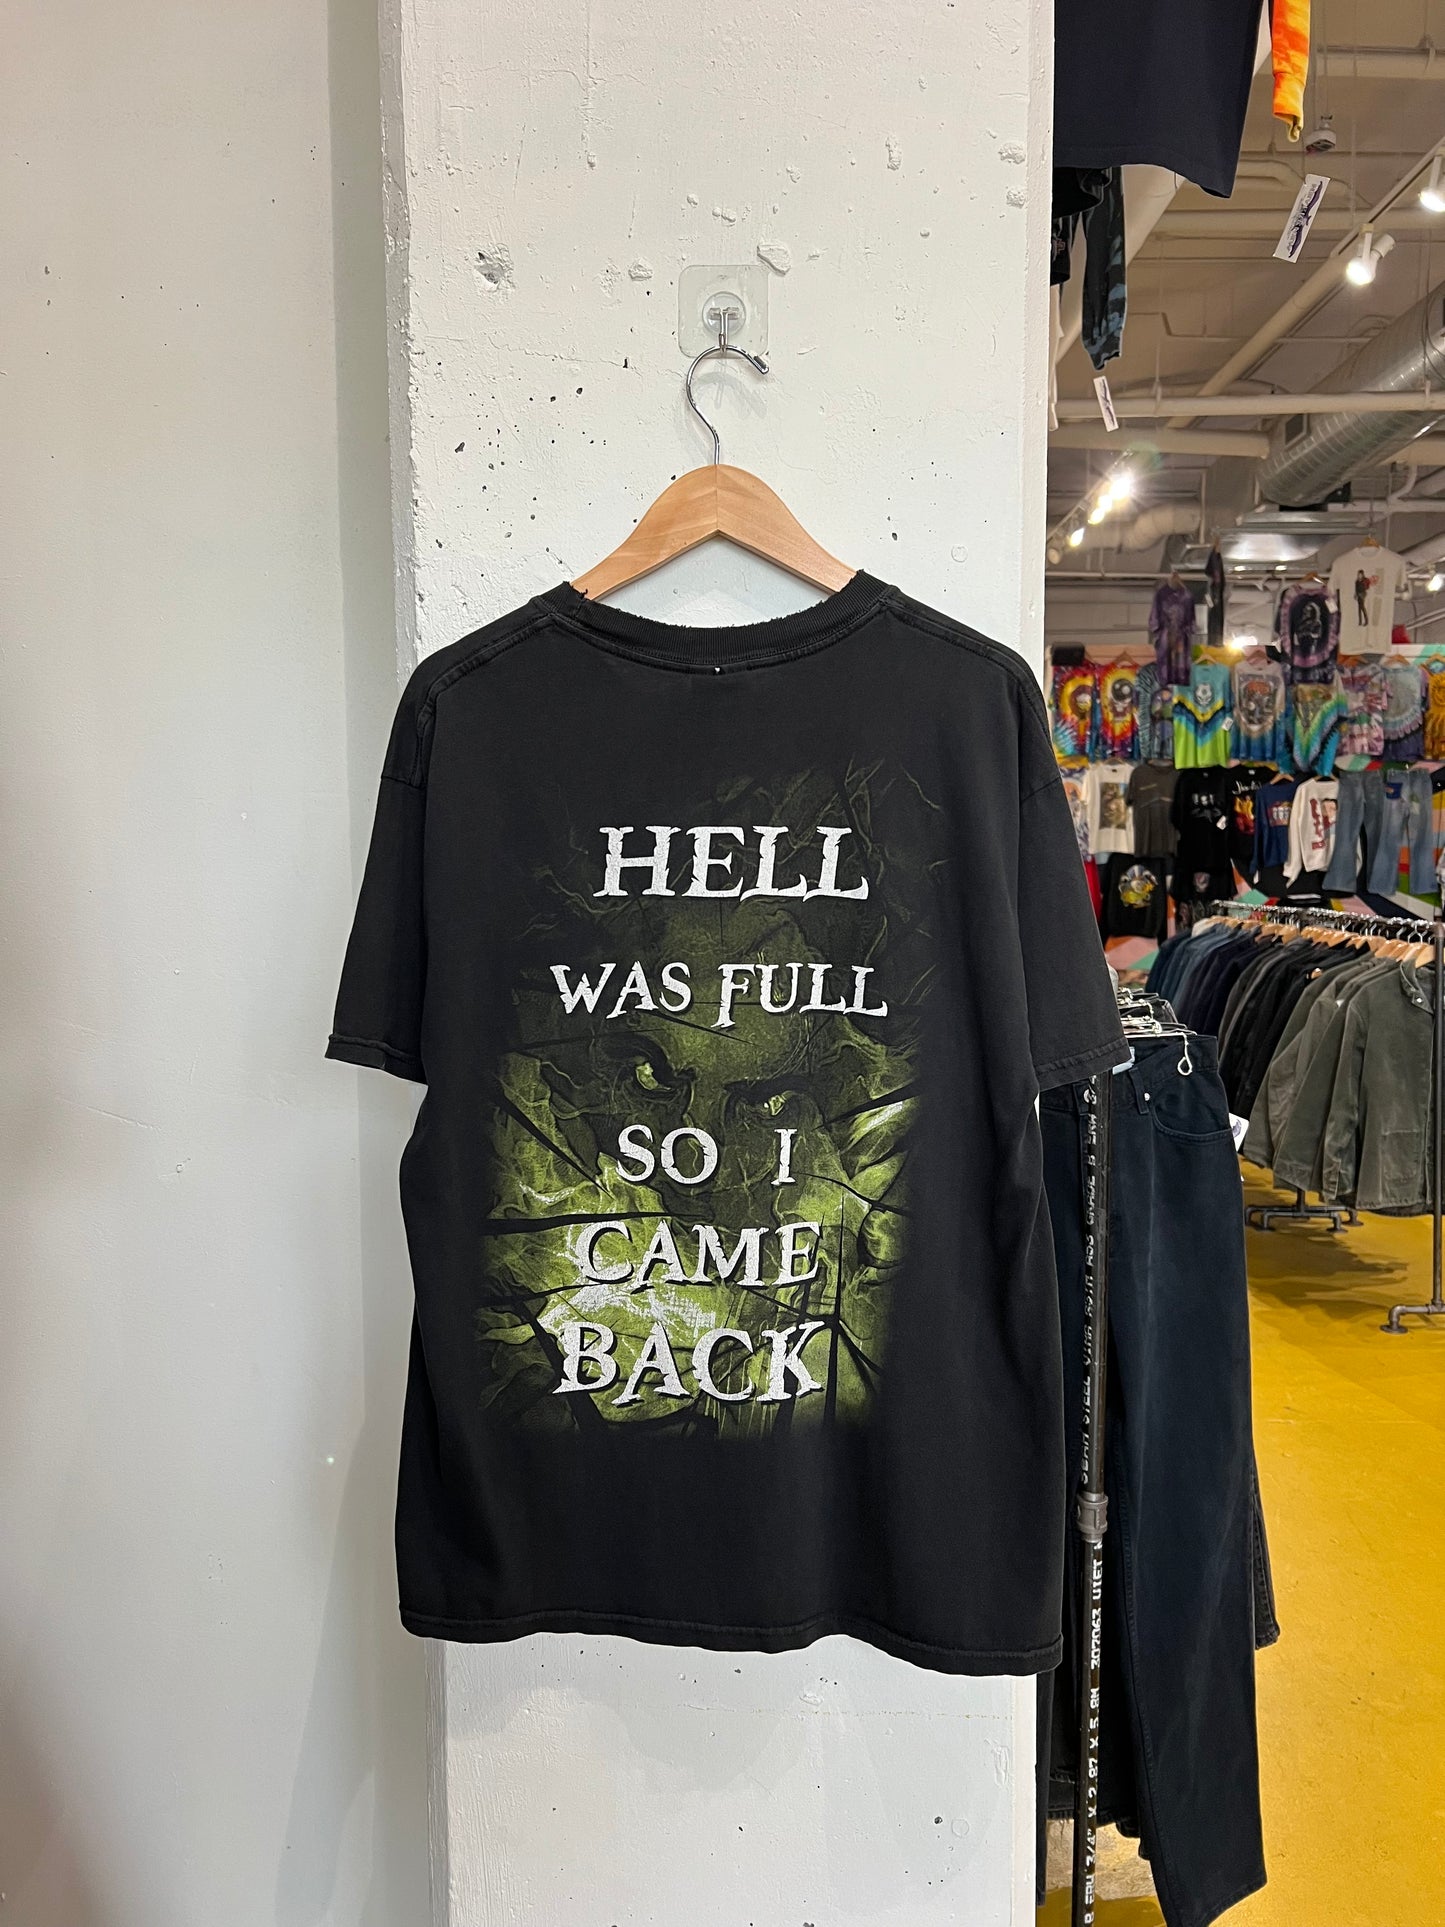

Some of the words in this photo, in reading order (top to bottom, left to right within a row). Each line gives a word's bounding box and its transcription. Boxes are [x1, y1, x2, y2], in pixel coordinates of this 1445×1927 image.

[593, 825, 869, 901] HELL
[550, 960, 692, 1020] WAS
[711, 962, 888, 1029] FULL
[615, 1124, 719, 1186] SO
[771, 1128, 799, 1186] I
[575, 1219, 825, 1291] CAME
[552, 1319, 827, 1405] BACK
